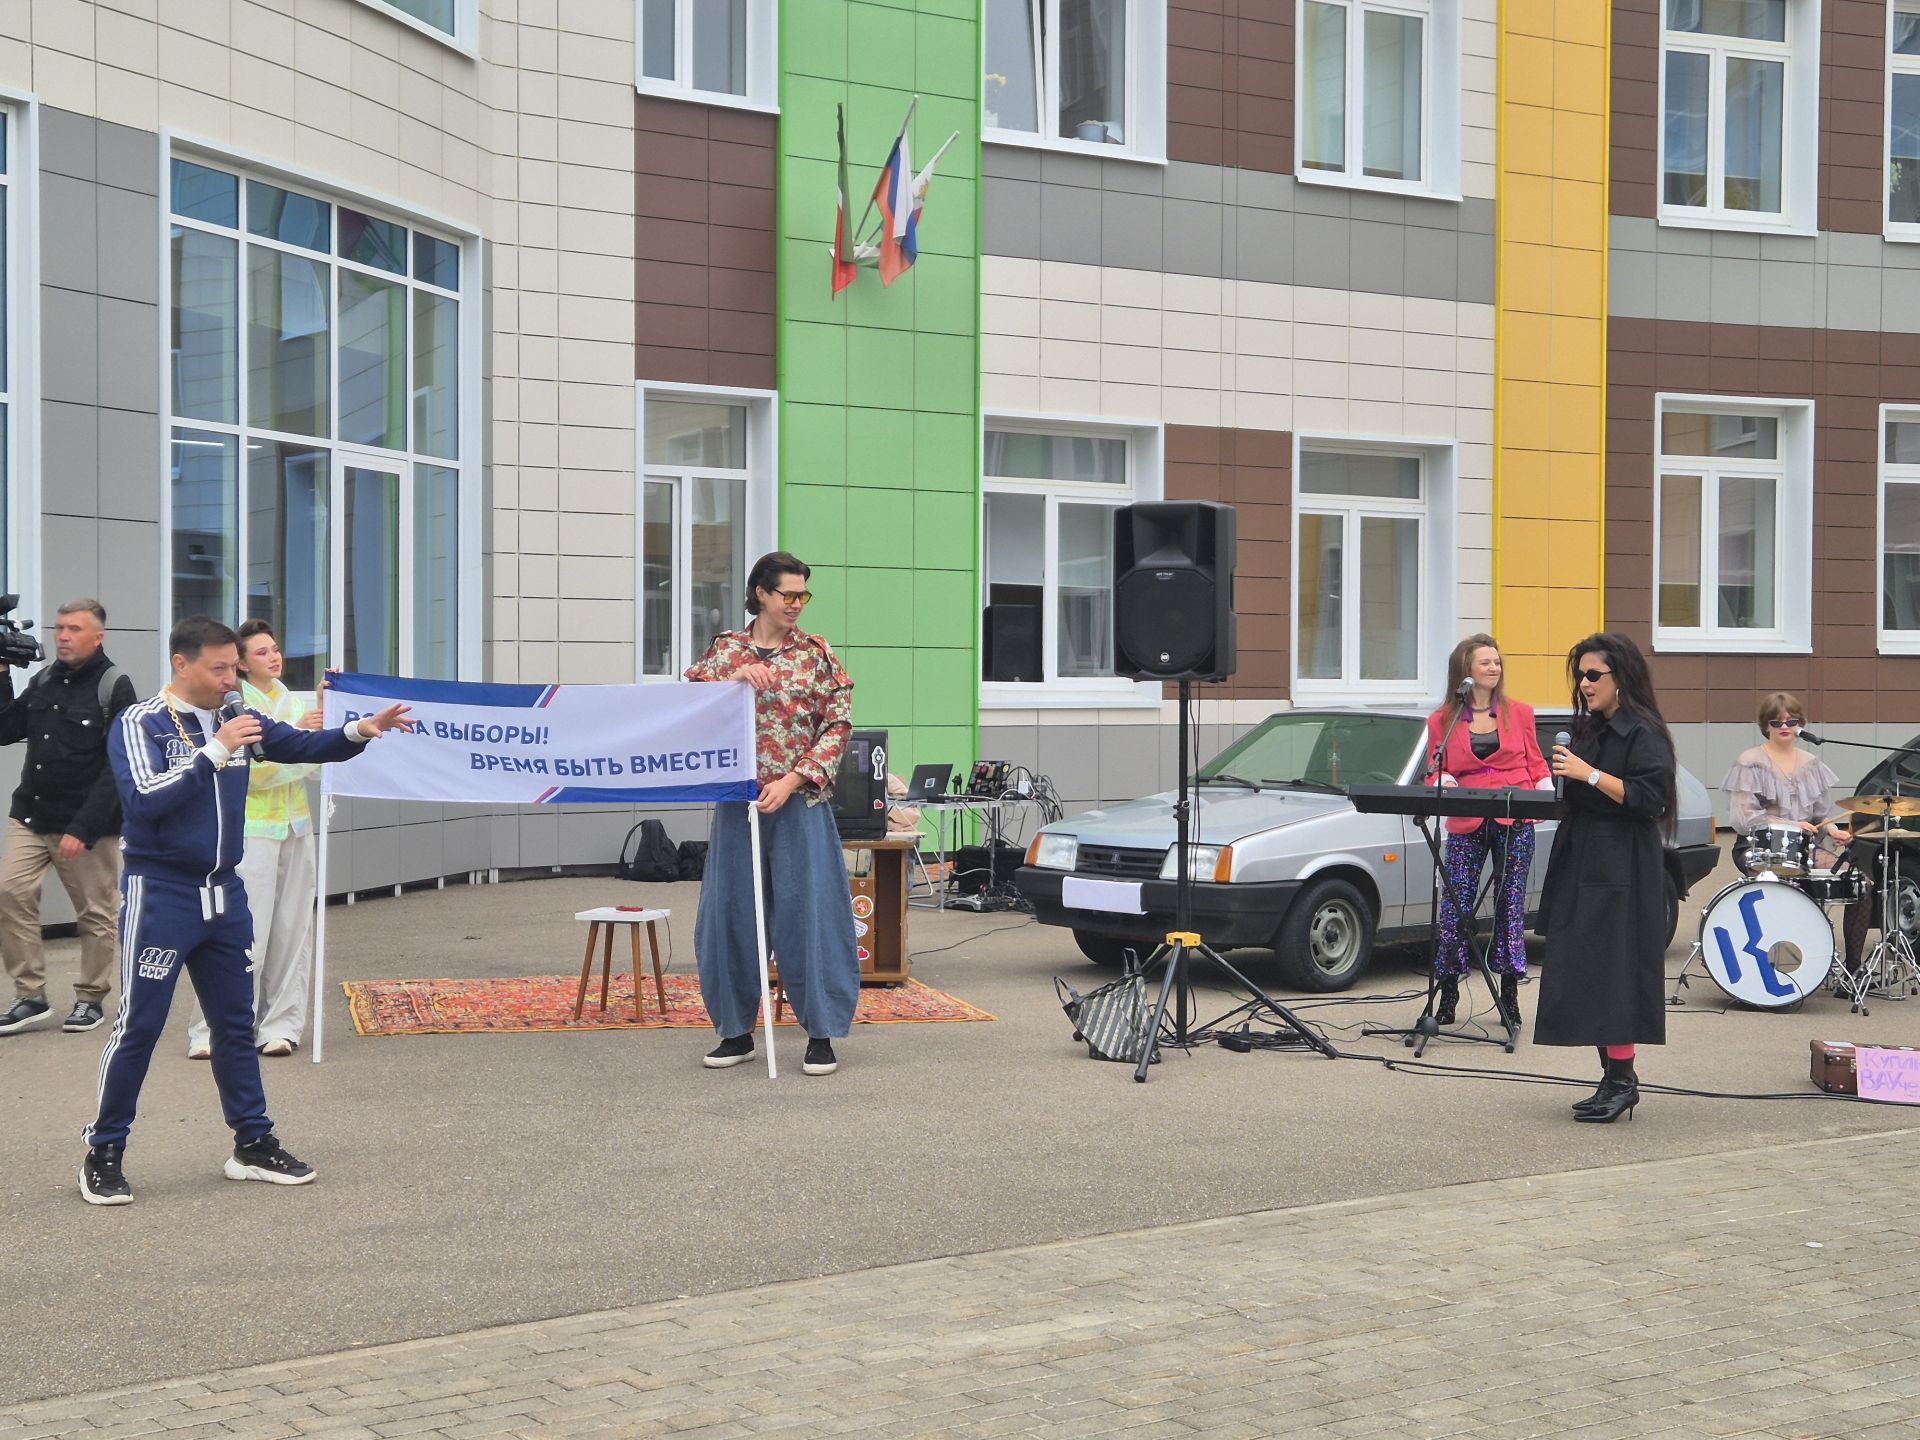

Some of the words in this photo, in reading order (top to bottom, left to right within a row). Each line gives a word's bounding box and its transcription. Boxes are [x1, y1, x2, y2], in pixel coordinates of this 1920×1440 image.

[434, 721, 549, 745] ВЫБОРЫ!
[470, 752, 549, 775] ВРЕМЯ
[554, 757, 624, 777] БЫТЬ
[629, 747, 738, 774] ВМЕСТЕ!
[138, 947, 178, 968] 80
[138, 964, 170, 980] СССР
